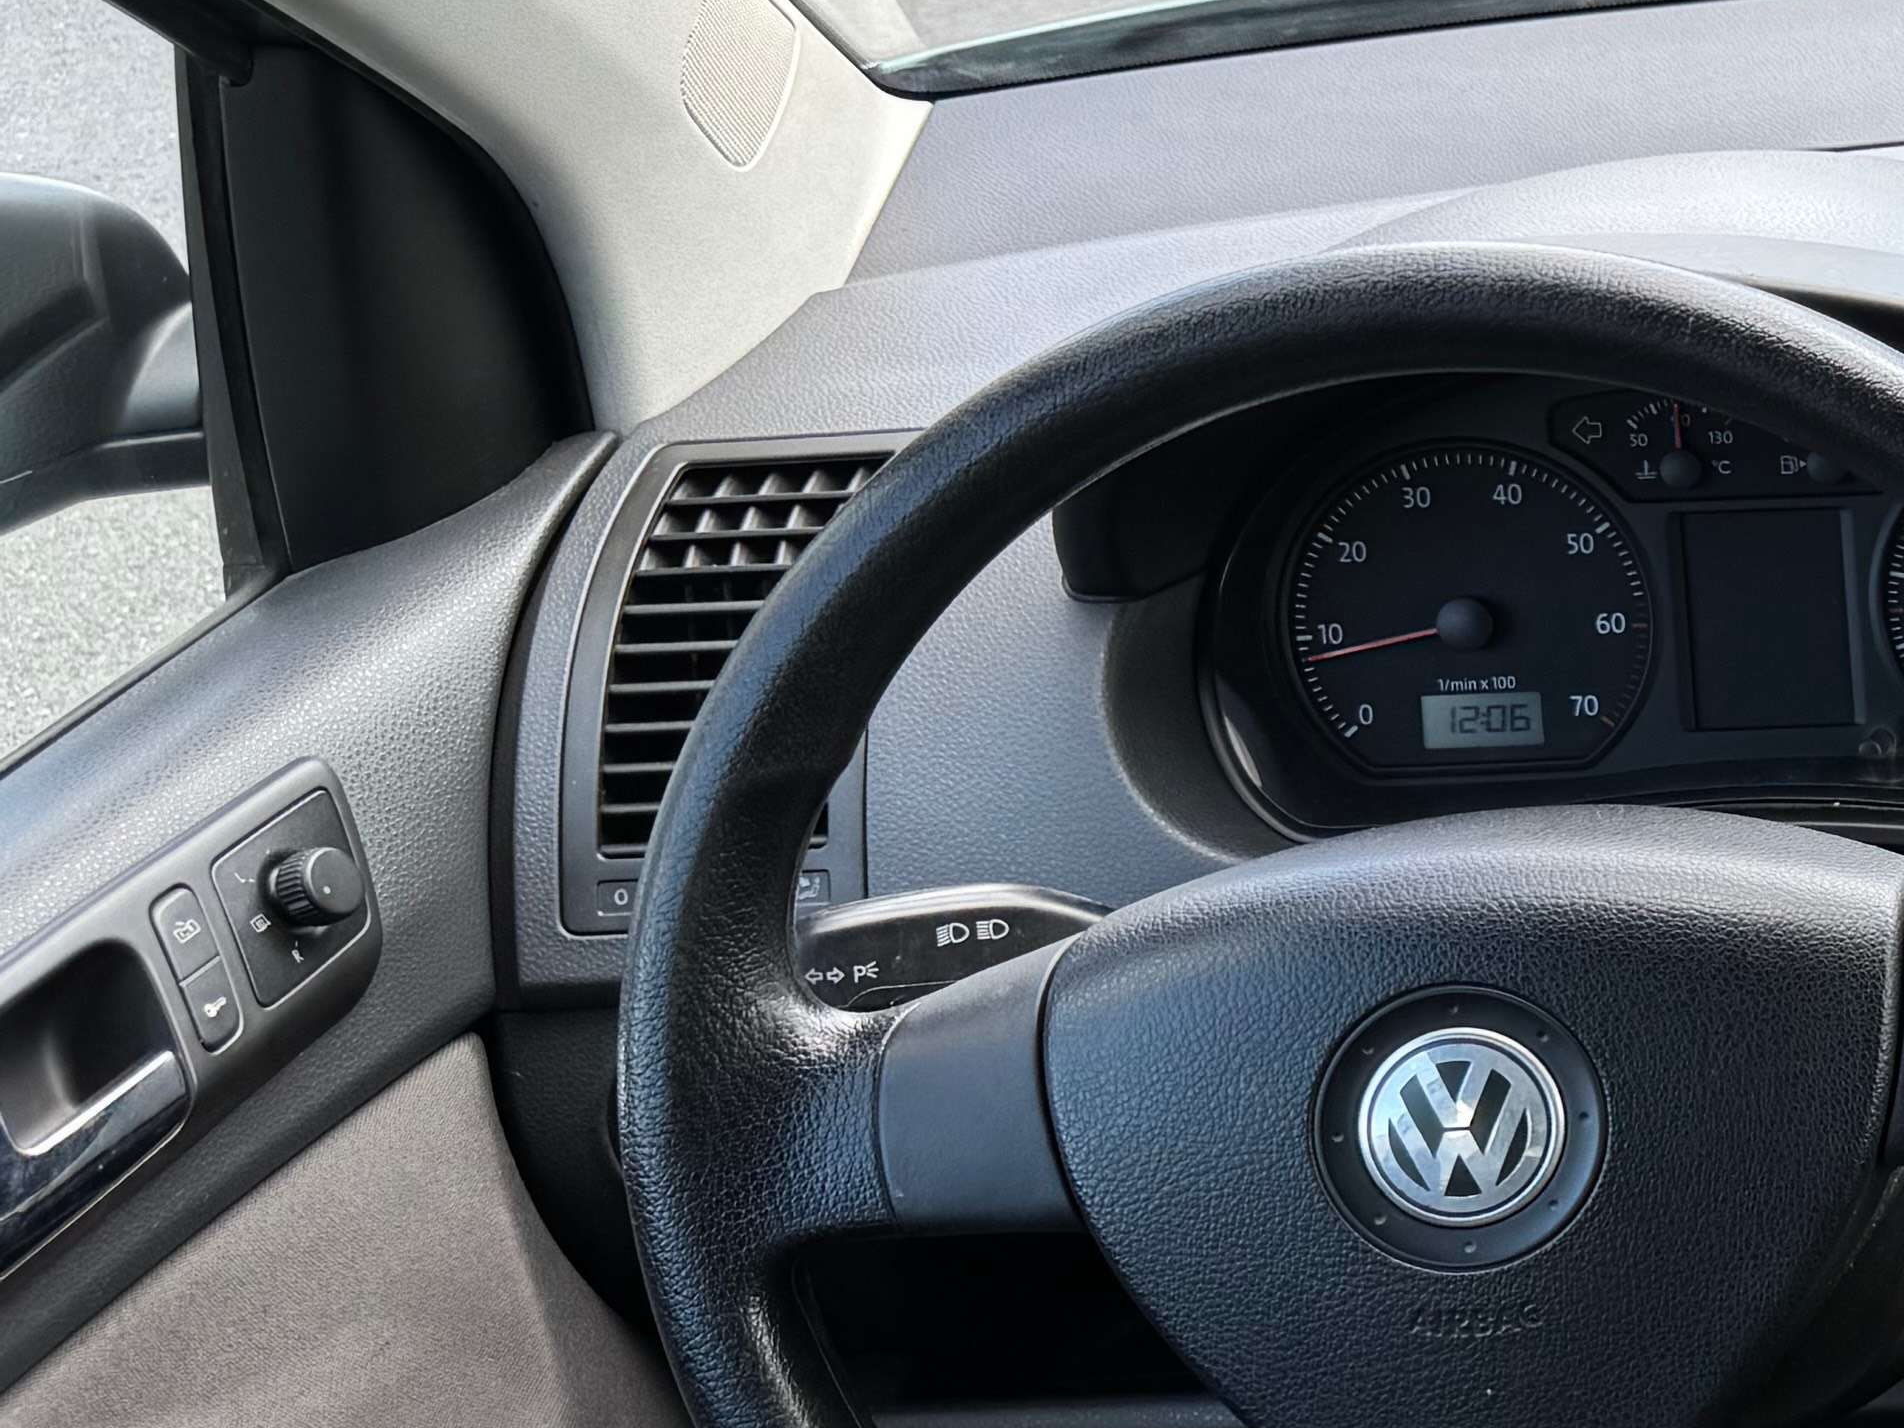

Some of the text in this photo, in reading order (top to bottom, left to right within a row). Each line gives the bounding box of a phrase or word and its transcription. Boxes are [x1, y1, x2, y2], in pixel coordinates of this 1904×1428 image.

[1629, 433, 1648, 447] 50
[1708, 431, 1734, 445] 130
[1403, 486, 1432, 509] 30
[1493, 483, 1523, 505] 40
[1338, 540, 1368, 563] 20
[1566, 532, 1595, 555] 50
[1317, 623, 1344, 644] 10
[1595, 613, 1626, 635] 60
[1437, 676, 1516, 692] 1/min x 100
[1358, 703, 1374, 725] 0
[1569, 694, 1599, 717] 70
[1451, 703, 1532, 734] 12:06
